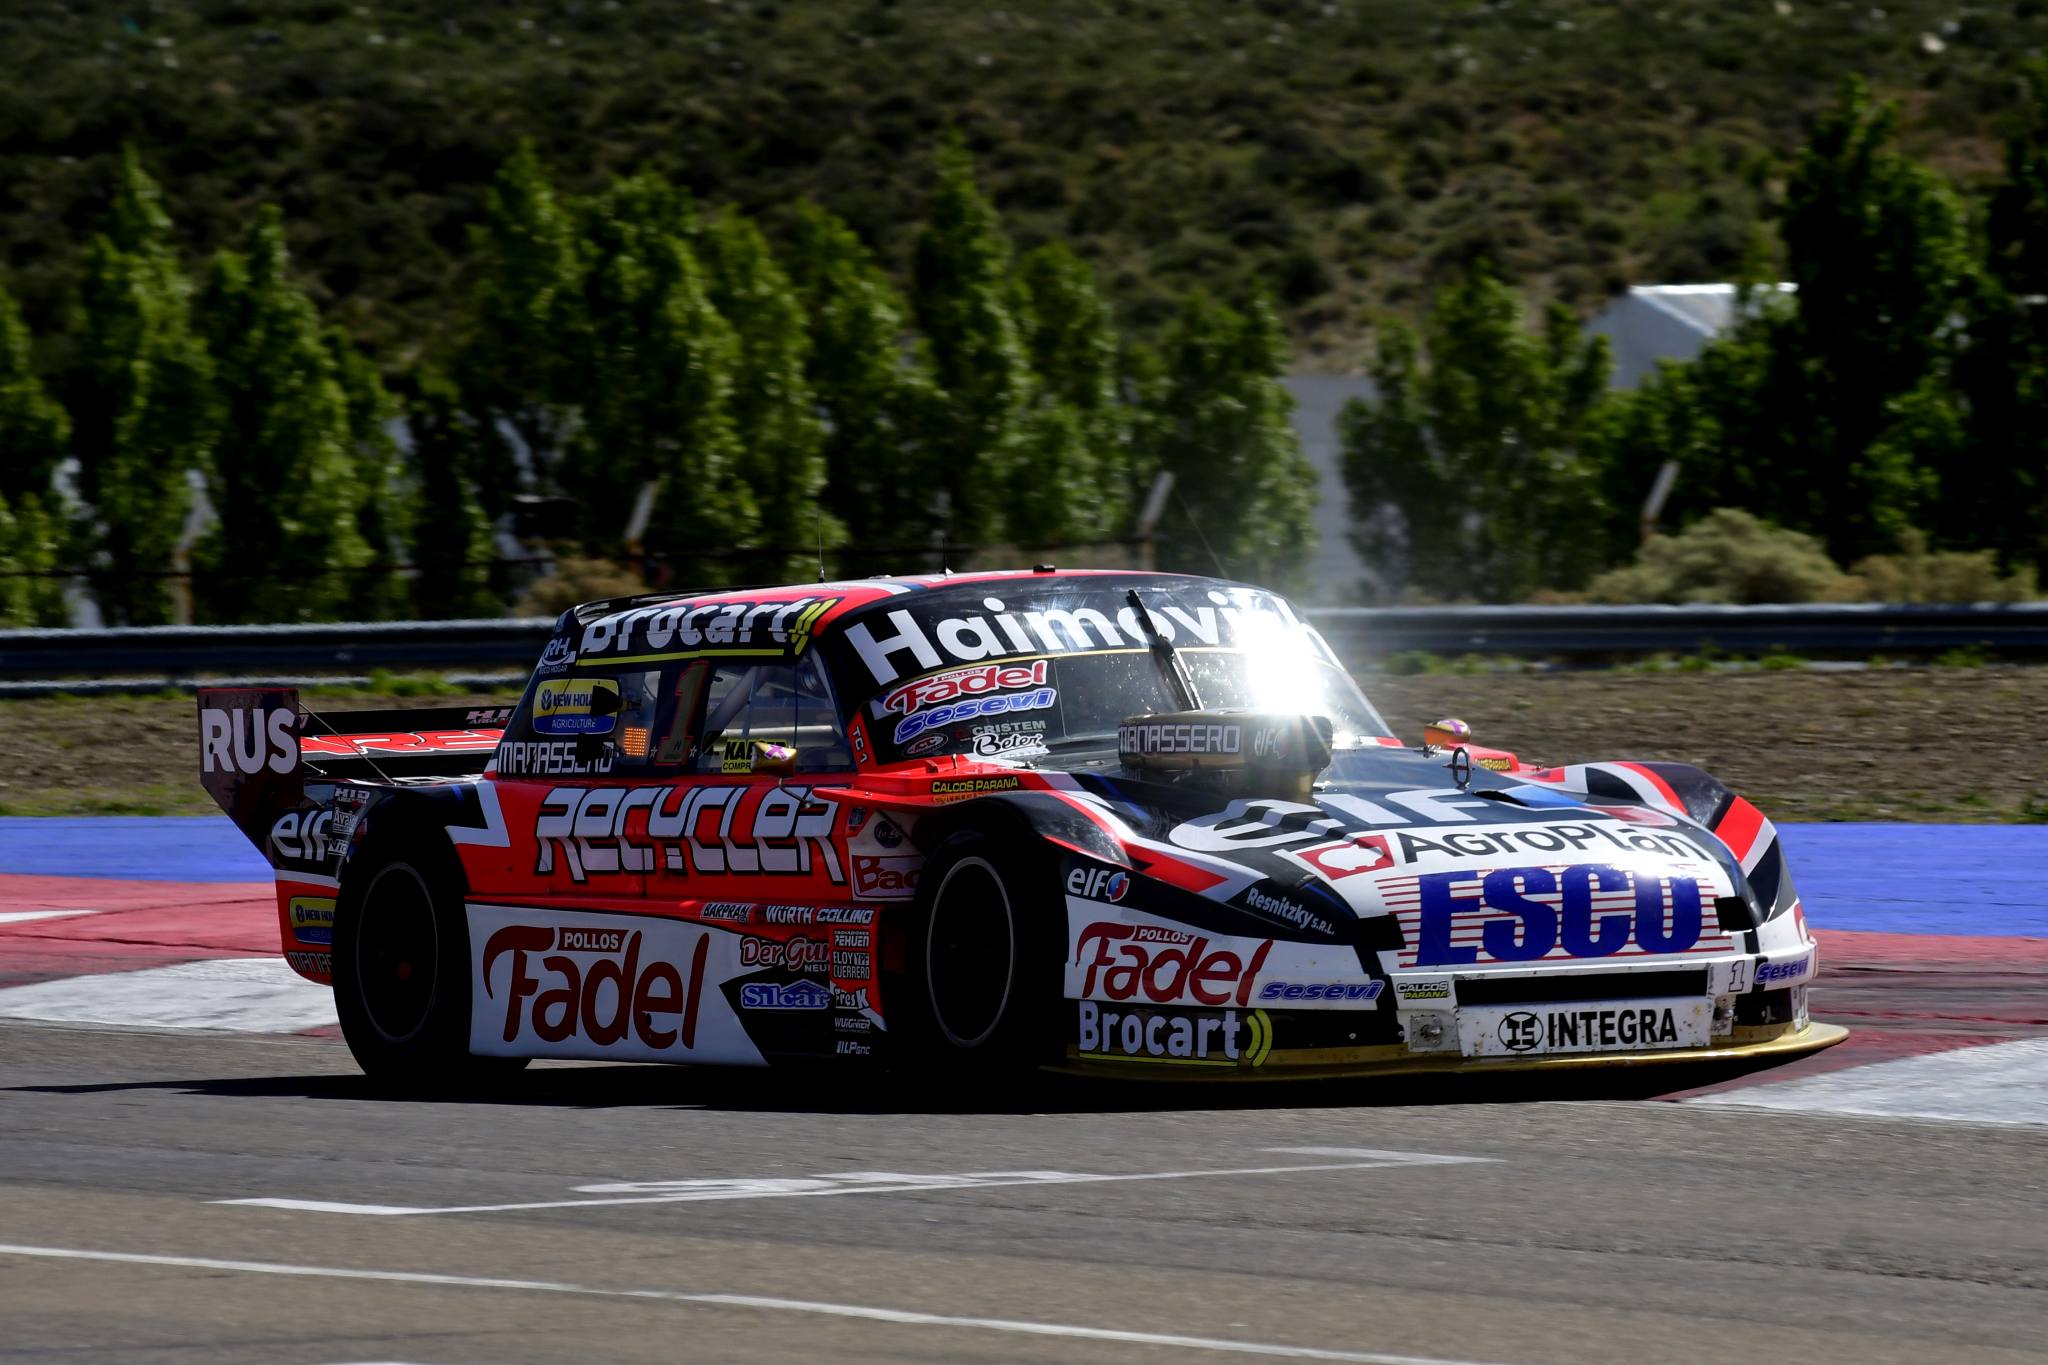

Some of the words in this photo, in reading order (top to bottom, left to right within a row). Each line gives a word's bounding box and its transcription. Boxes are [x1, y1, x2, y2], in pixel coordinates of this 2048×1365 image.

[884, 660, 1048, 716] Fadel
[551, 717, 597, 729] AGRICULTURE
[971, 720, 1047, 735] CRISTEM
[201, 707, 298, 775] RUS
[1119, 724, 1242, 753] MANASSERO
[932, 780, 974, 793] CALCOS
[976, 776, 1018, 791] PARANA
[270, 809, 333, 862] elf
[1067, 867, 1109, 898] elf
[765, 904, 815, 925] WÜRTH
[1246, 887, 1315, 930] Resnitzky
[564, 932, 619, 951] POLLOS
[1138, 928, 1190, 944] POLLOS
[741, 937, 784, 967] Der
[1076, 921, 1274, 1008] Fadel
[482, 925, 710, 1051] Fadel
[1396, 980, 1449, 993] CALCOS
[1728, 959, 1745, 993] 1
[742, 983, 830, 1008] Silcar
[1079, 1000, 1241, 1060] Brocart
[1547, 1007, 1679, 1047] INTEGRA
